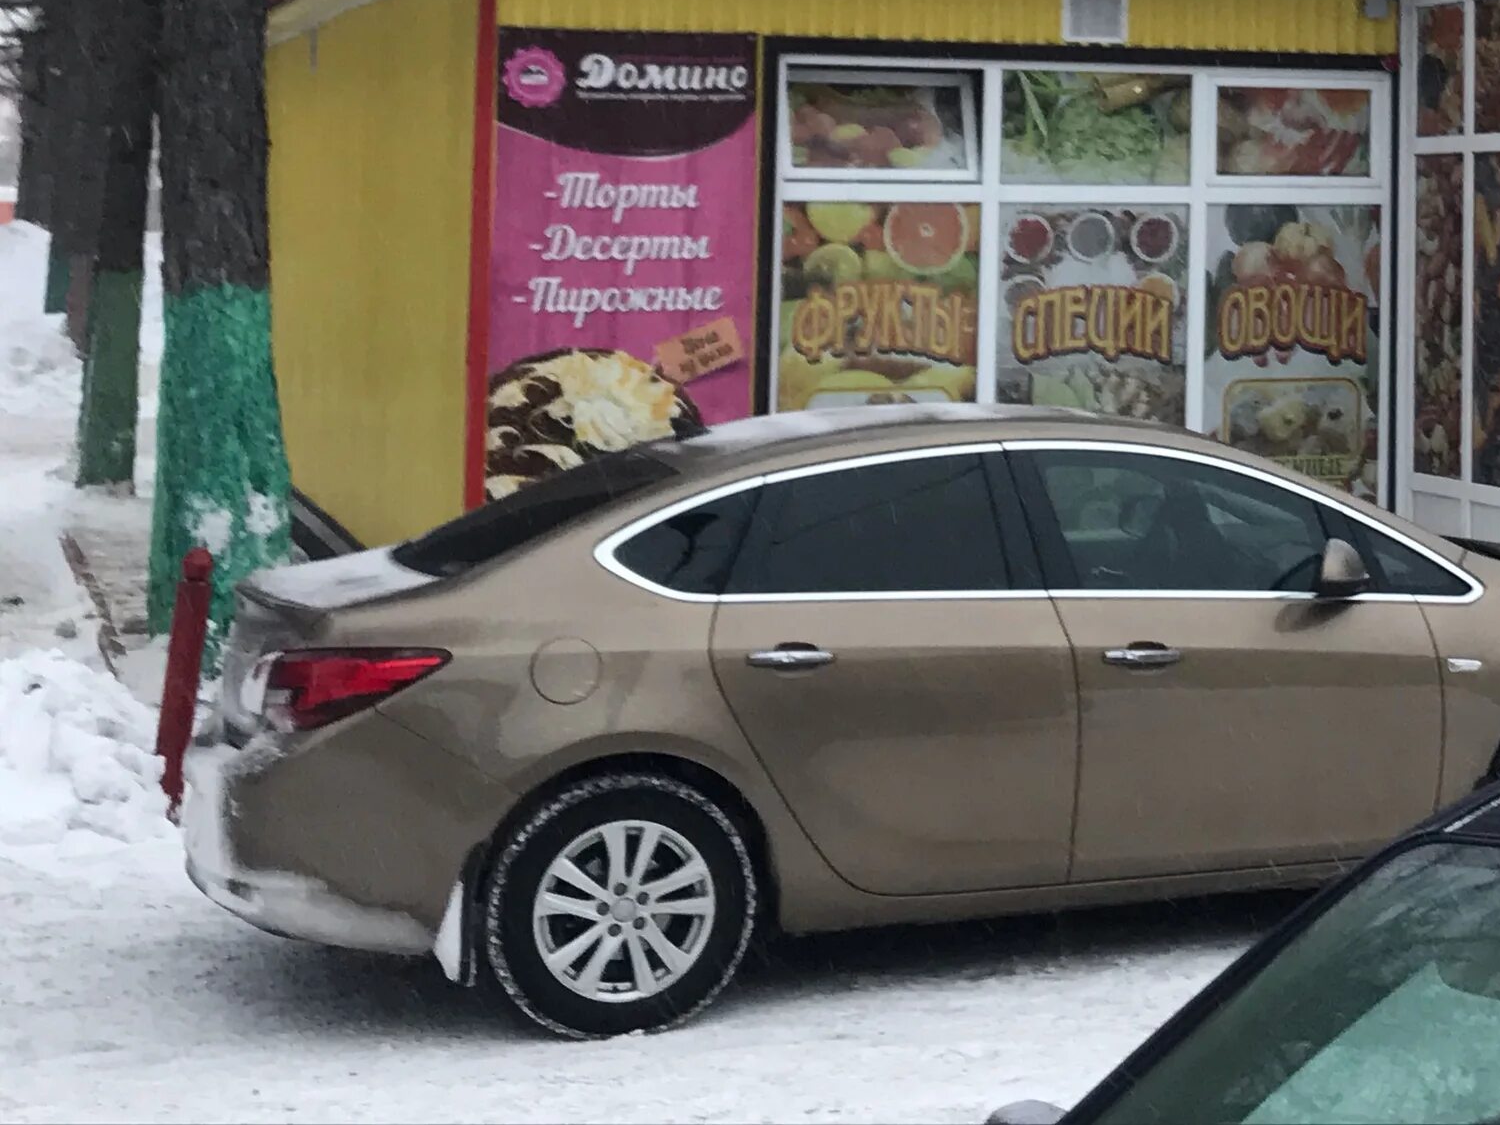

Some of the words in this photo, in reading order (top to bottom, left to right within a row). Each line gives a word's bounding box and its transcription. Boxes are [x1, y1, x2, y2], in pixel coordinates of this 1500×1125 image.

[576, 53, 749, 91] Домино
[792, 282, 967, 365] ФРУКТЫ
[1013, 284, 1174, 364] СПЕЦИИ
[1217, 282, 1368, 364] ОВОЩИ
